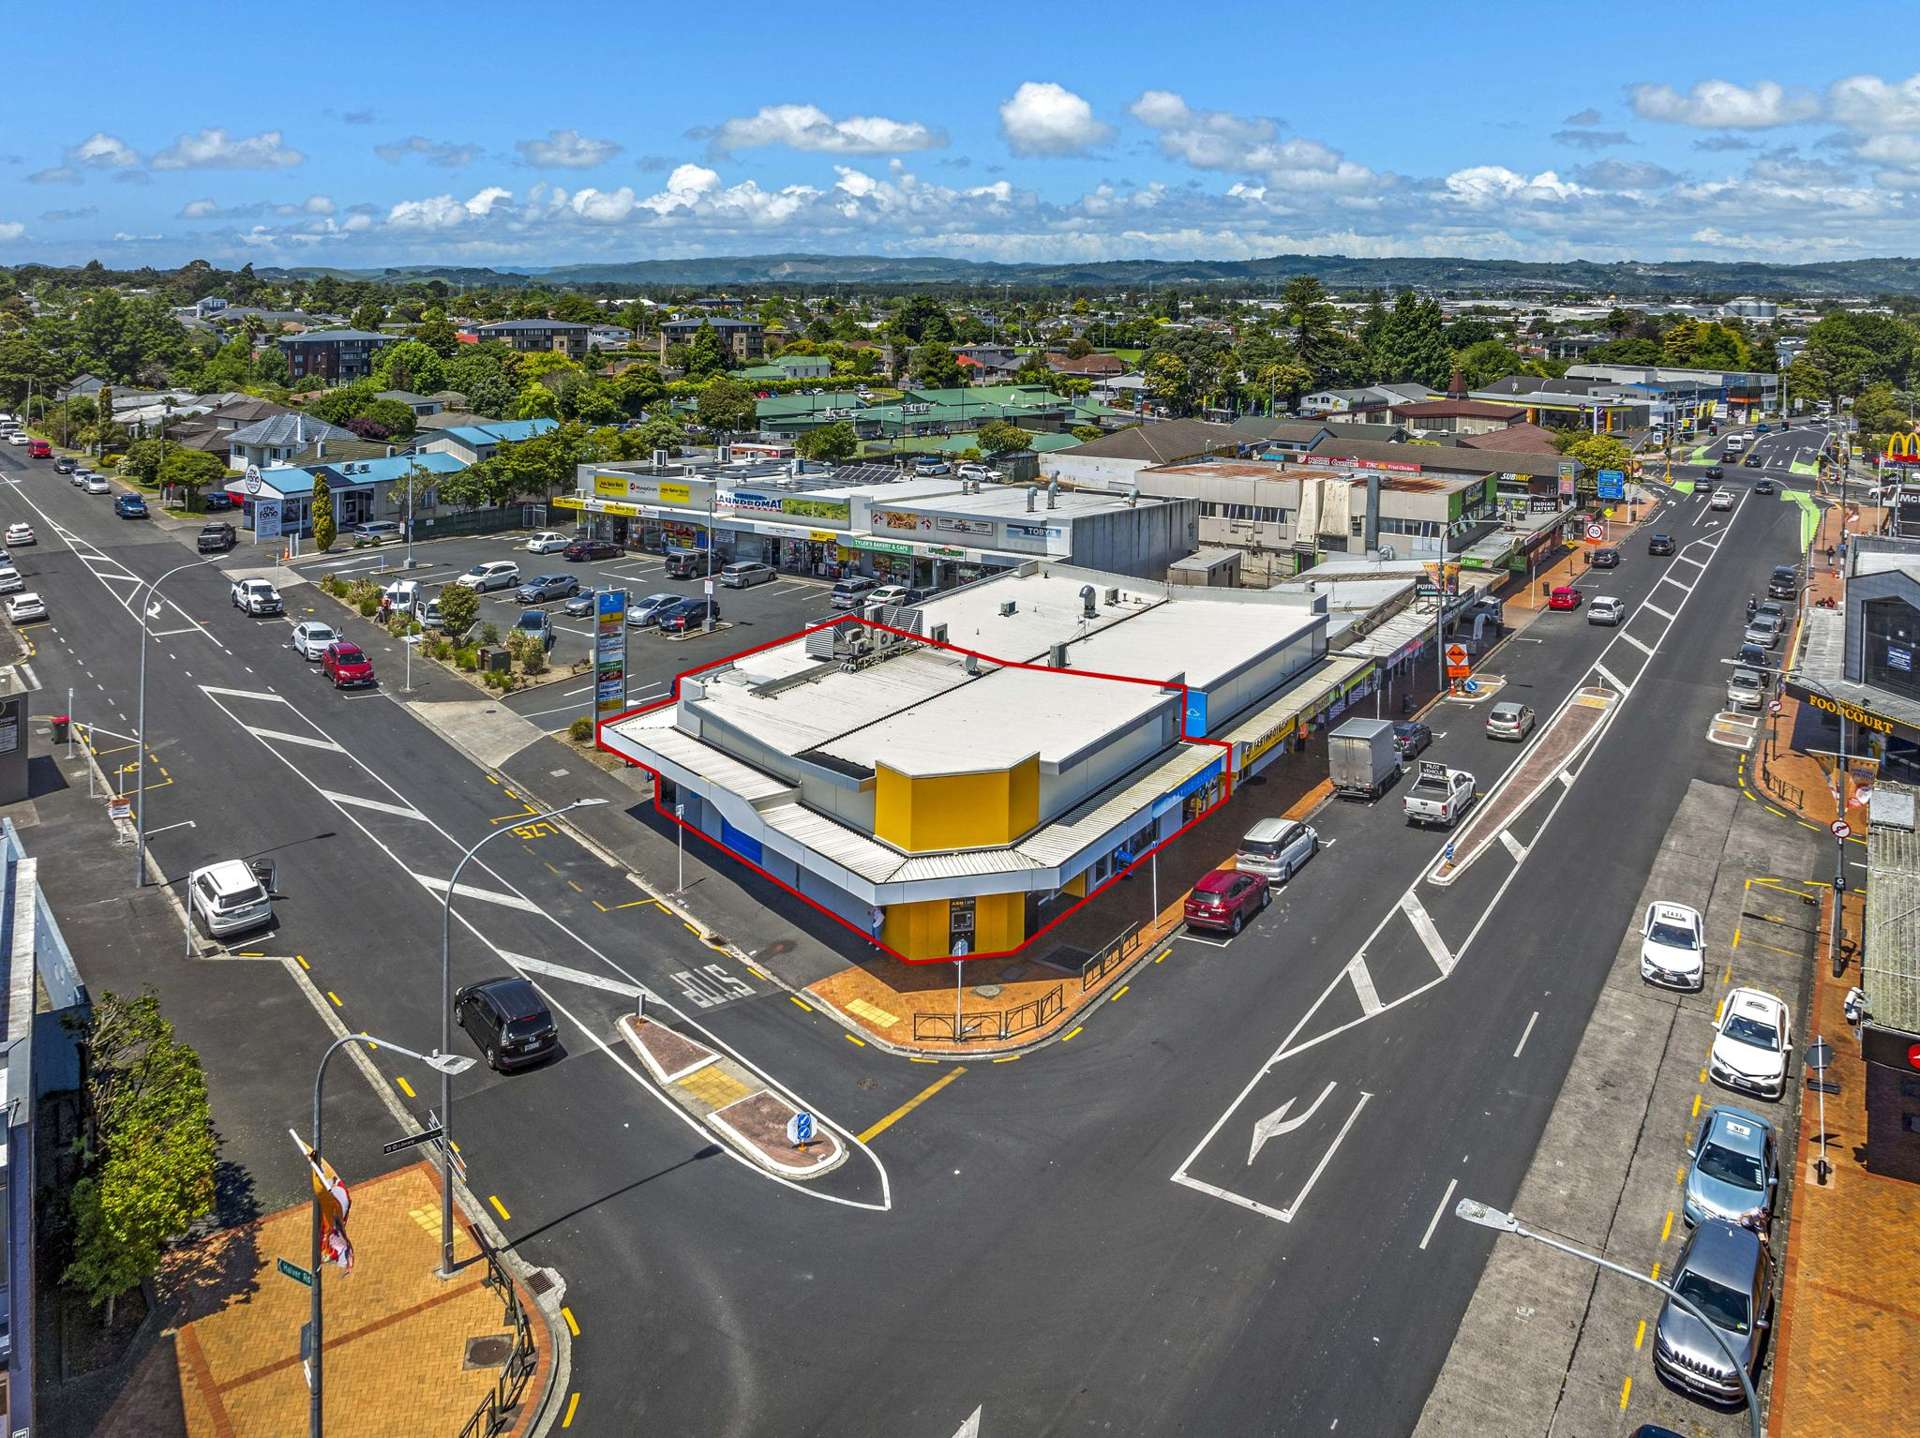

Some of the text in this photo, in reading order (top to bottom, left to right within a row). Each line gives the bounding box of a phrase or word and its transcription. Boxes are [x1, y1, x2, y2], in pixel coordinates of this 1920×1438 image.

[1500, 472, 1533, 481] SUBWAY
[1666, 910, 1683, 918] TAXI
[669, 964, 757, 1009] STOP
